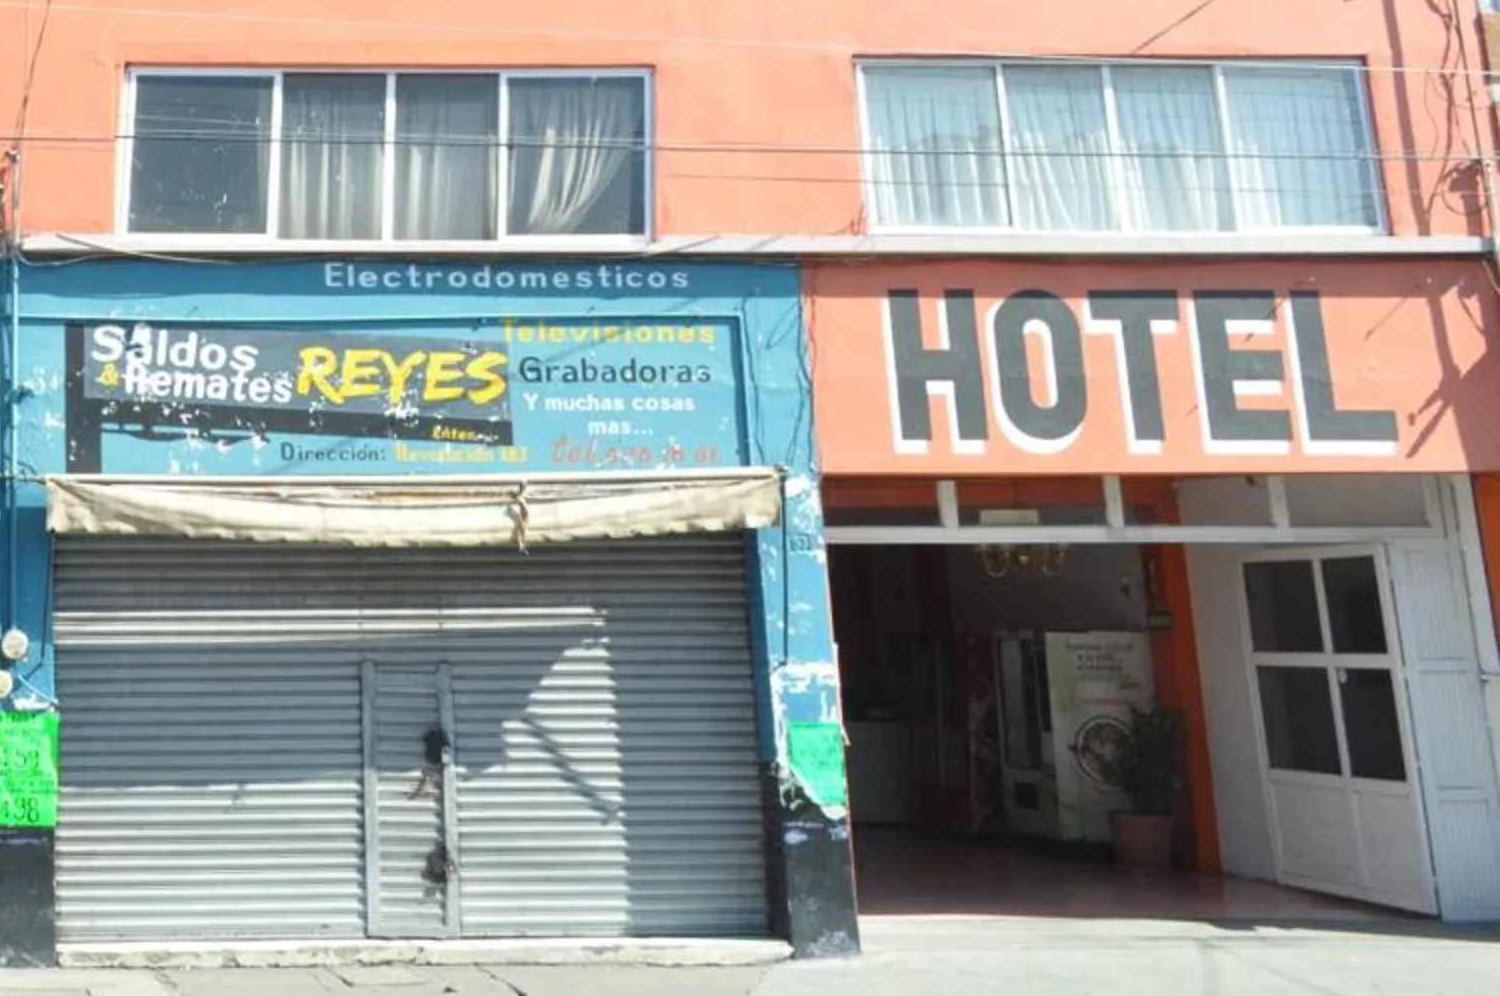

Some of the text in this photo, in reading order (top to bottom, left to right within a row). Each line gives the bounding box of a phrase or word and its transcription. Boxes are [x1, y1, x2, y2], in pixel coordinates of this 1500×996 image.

[323, 262, 691, 289] Electrodomesticos
[91, 323, 260, 371] Saldos
[502, 319, 716, 345] Televisiones
[122, 361, 294, 404] Remates
[296, 346, 507, 406] REYES
[518, 356, 712, 384] Grabadoras
[881, 289, 1399, 455] HOTEL
[522, 393, 697, 411] Y muchas cosas
